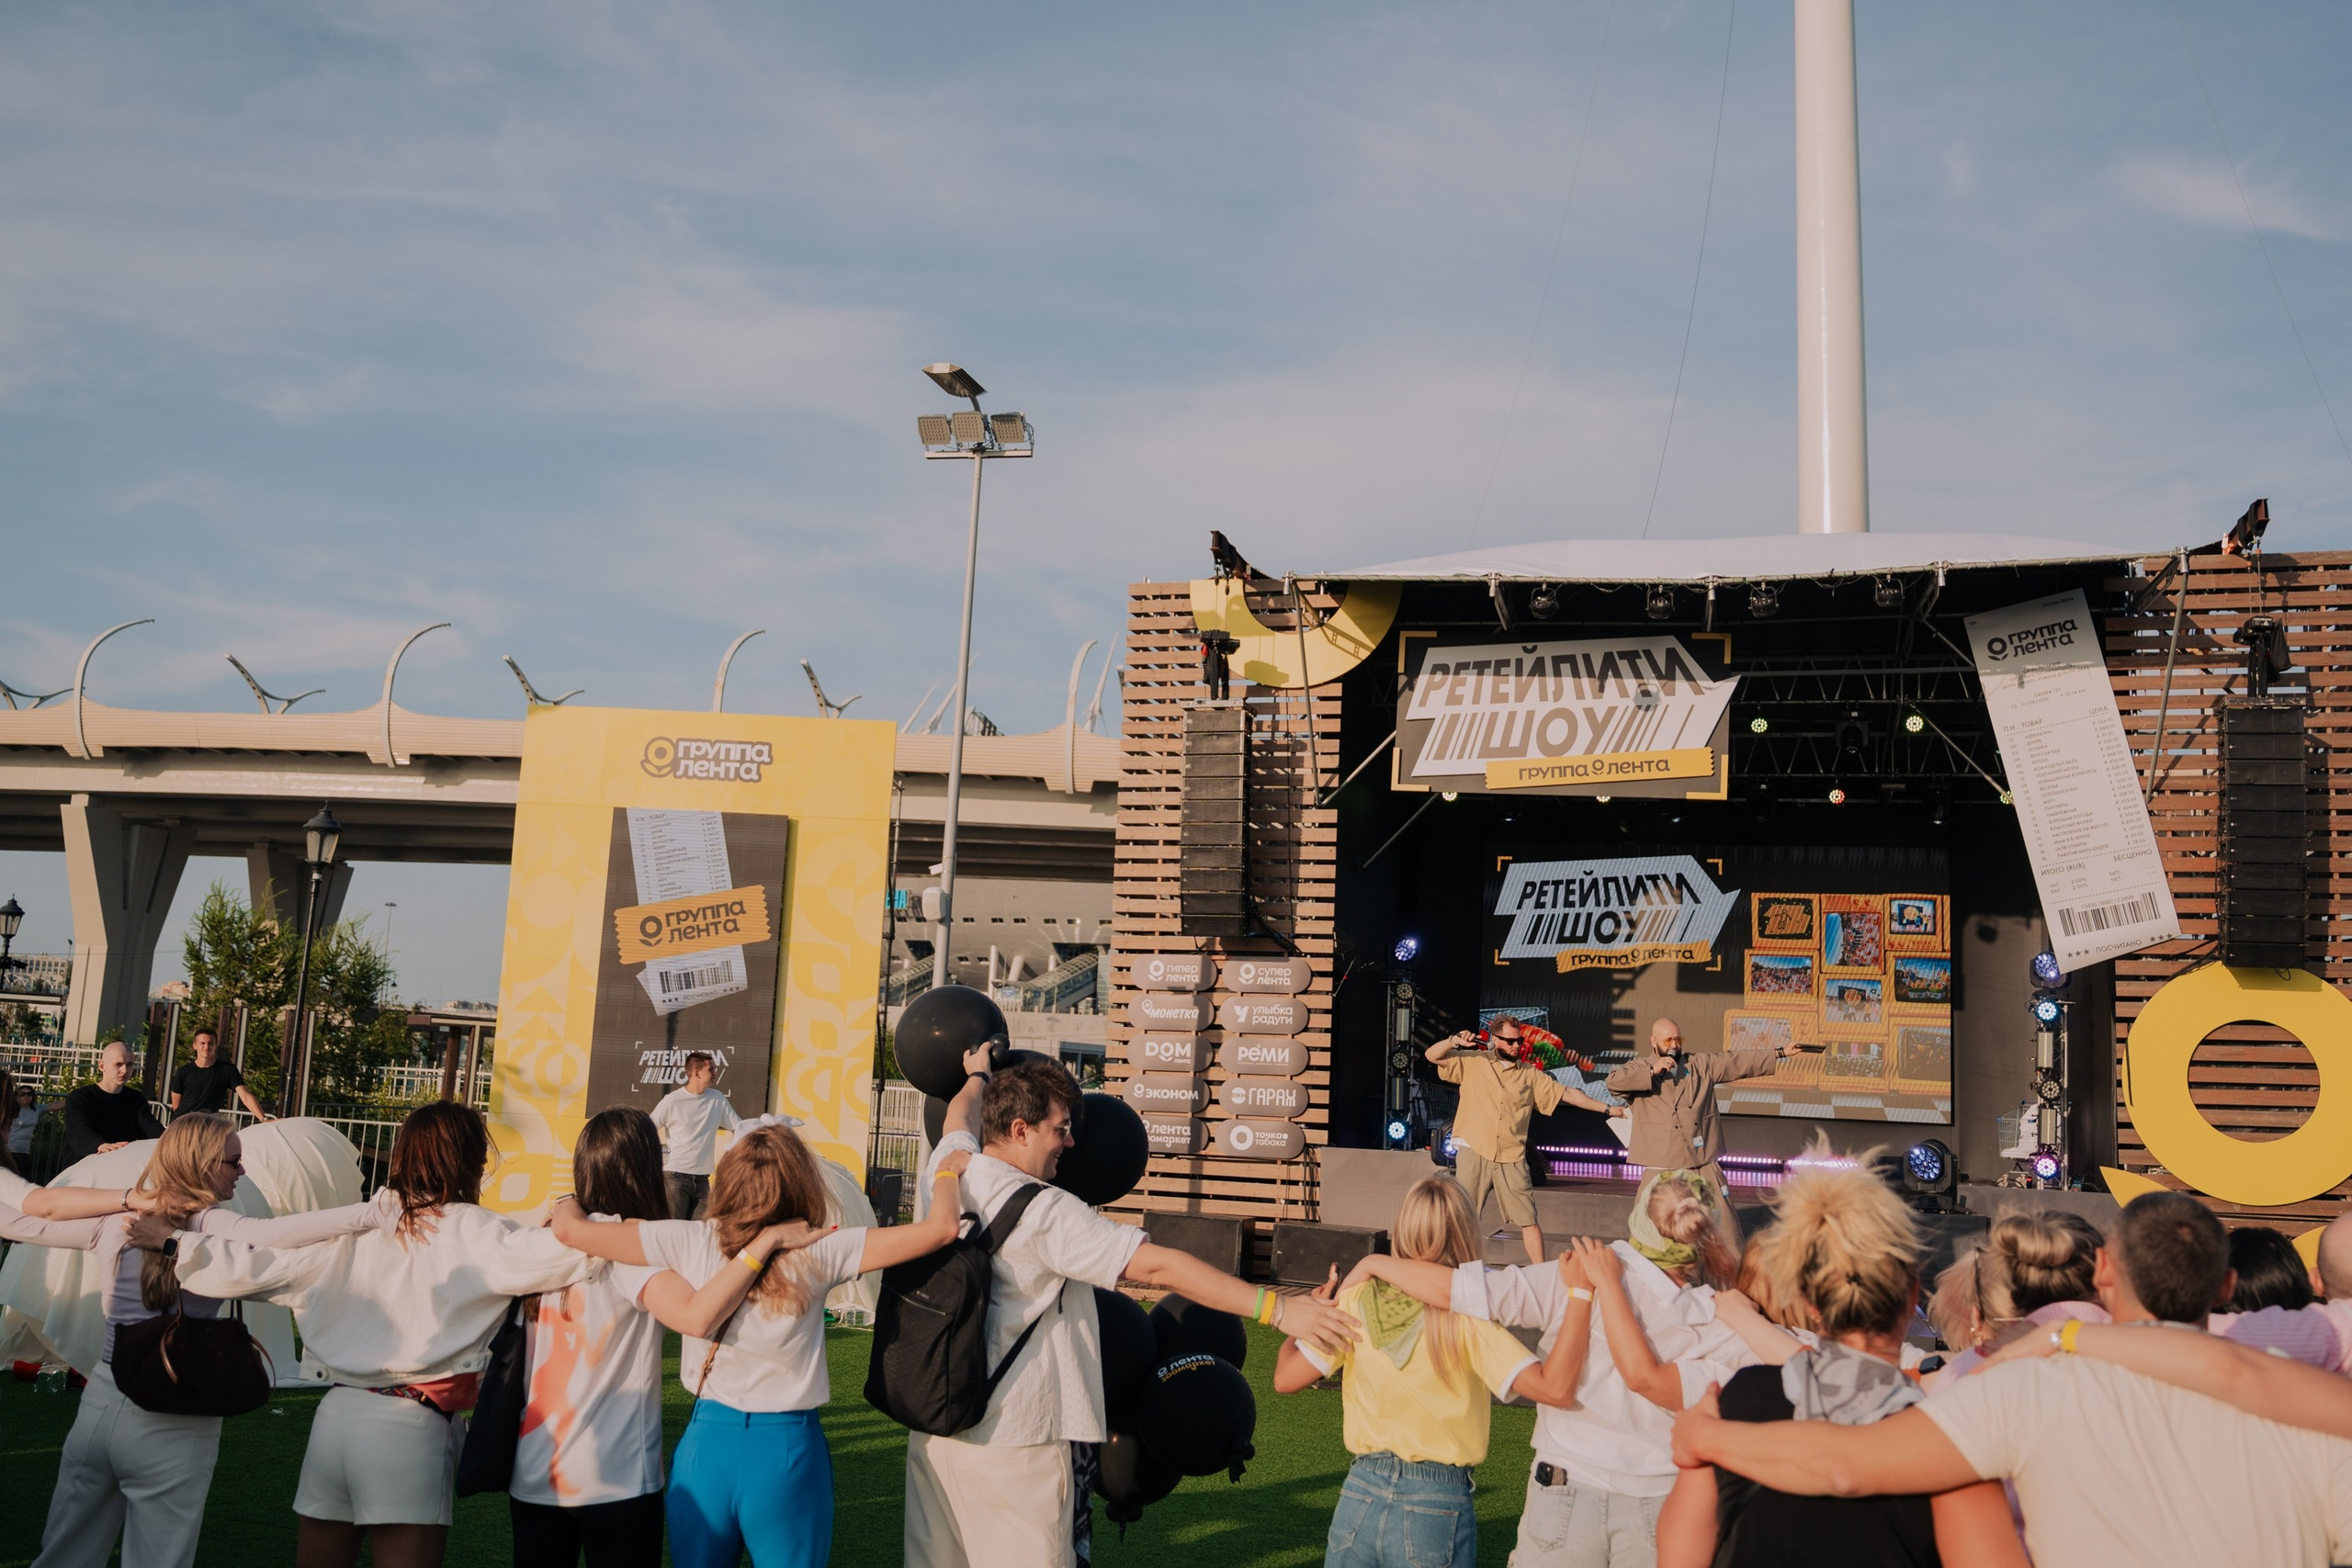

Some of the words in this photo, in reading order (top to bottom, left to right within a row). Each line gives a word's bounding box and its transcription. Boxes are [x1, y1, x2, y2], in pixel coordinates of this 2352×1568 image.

[2007, 619, 2077, 645] группа
[2013, 633, 2075, 658] лента
[2020, 717, 2042, 728] ТОВАР
[2088, 705, 2108, 715] ЦЕНА
[1476, 705, 1619, 759] ШОУ
[677, 740, 771, 762] группа
[676, 760, 759, 780] лента
[1519, 761, 1589, 781] группа
[1606, 757, 1670, 775] лента
[2041, 866, 2065, 876] ИТОГО
[2113, 849, 2153, 862] БЕСЦЕННО
[665, 900, 746, 927] группа
[669, 918, 741, 943] лента
[1555, 910, 1642, 944] ШОУ
[2096, 939, 2142, 953] ПОСЧИТАНО
[1571, 950, 1630, 967] группа
[1642, 946, 1695, 962] лента
[1165, 974, 1200, 983] лента
[1167, 964, 1198, 975] гипер
[1258, 967, 1292, 977] супер
[1257, 976, 1292, 986] лента
[1149, 1008, 1200, 1020] монетка
[1252, 1004, 1293, 1015] улыбка
[1252, 1015, 1293, 1025] радуги
[1249, 1088, 1296, 1107] ГАРАЖ
[1150, 1124, 1192, 1135] лента
[1255, 1132, 1283, 1140] точка
[1148, 1134, 1192, 1147] омаркет
[1255, 1138, 1286, 1147] табака
[1160, 1360, 1216, 1382] зоомаркет
[1170, 1355, 1215, 1371] лента
